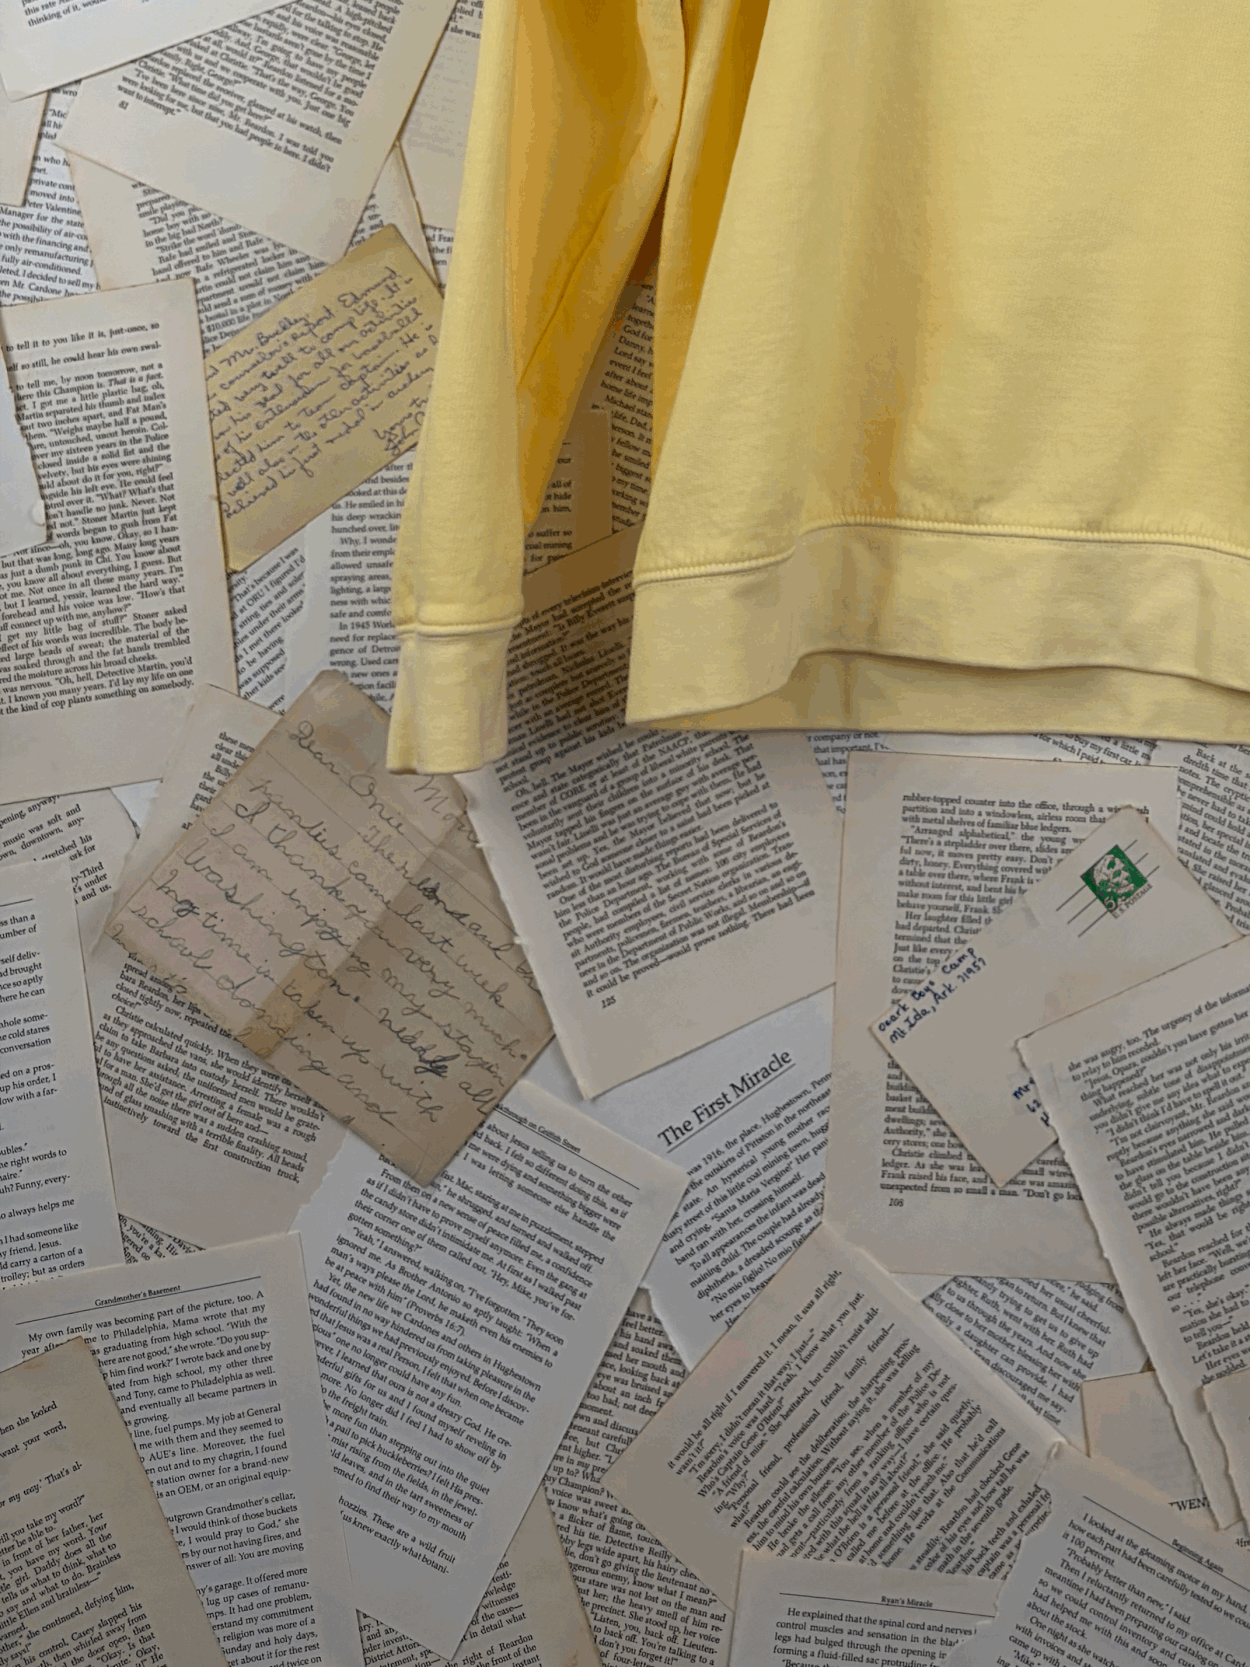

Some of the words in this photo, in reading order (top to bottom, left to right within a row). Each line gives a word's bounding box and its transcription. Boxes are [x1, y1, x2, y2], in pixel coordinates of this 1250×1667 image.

[601, 996, 616, 1008] 125
[657, 1120, 694, 1147] The
[691, 1091, 732, 1125] First
[729, 1051, 792, 1099] Miracle
[94, 1291, 147, 1307] Grandmother's
[147, 1285, 181, 1297] Basement
[877, 1595, 905, 1605] Ryan's
[906, 1597, 934, 1608] Miracle
